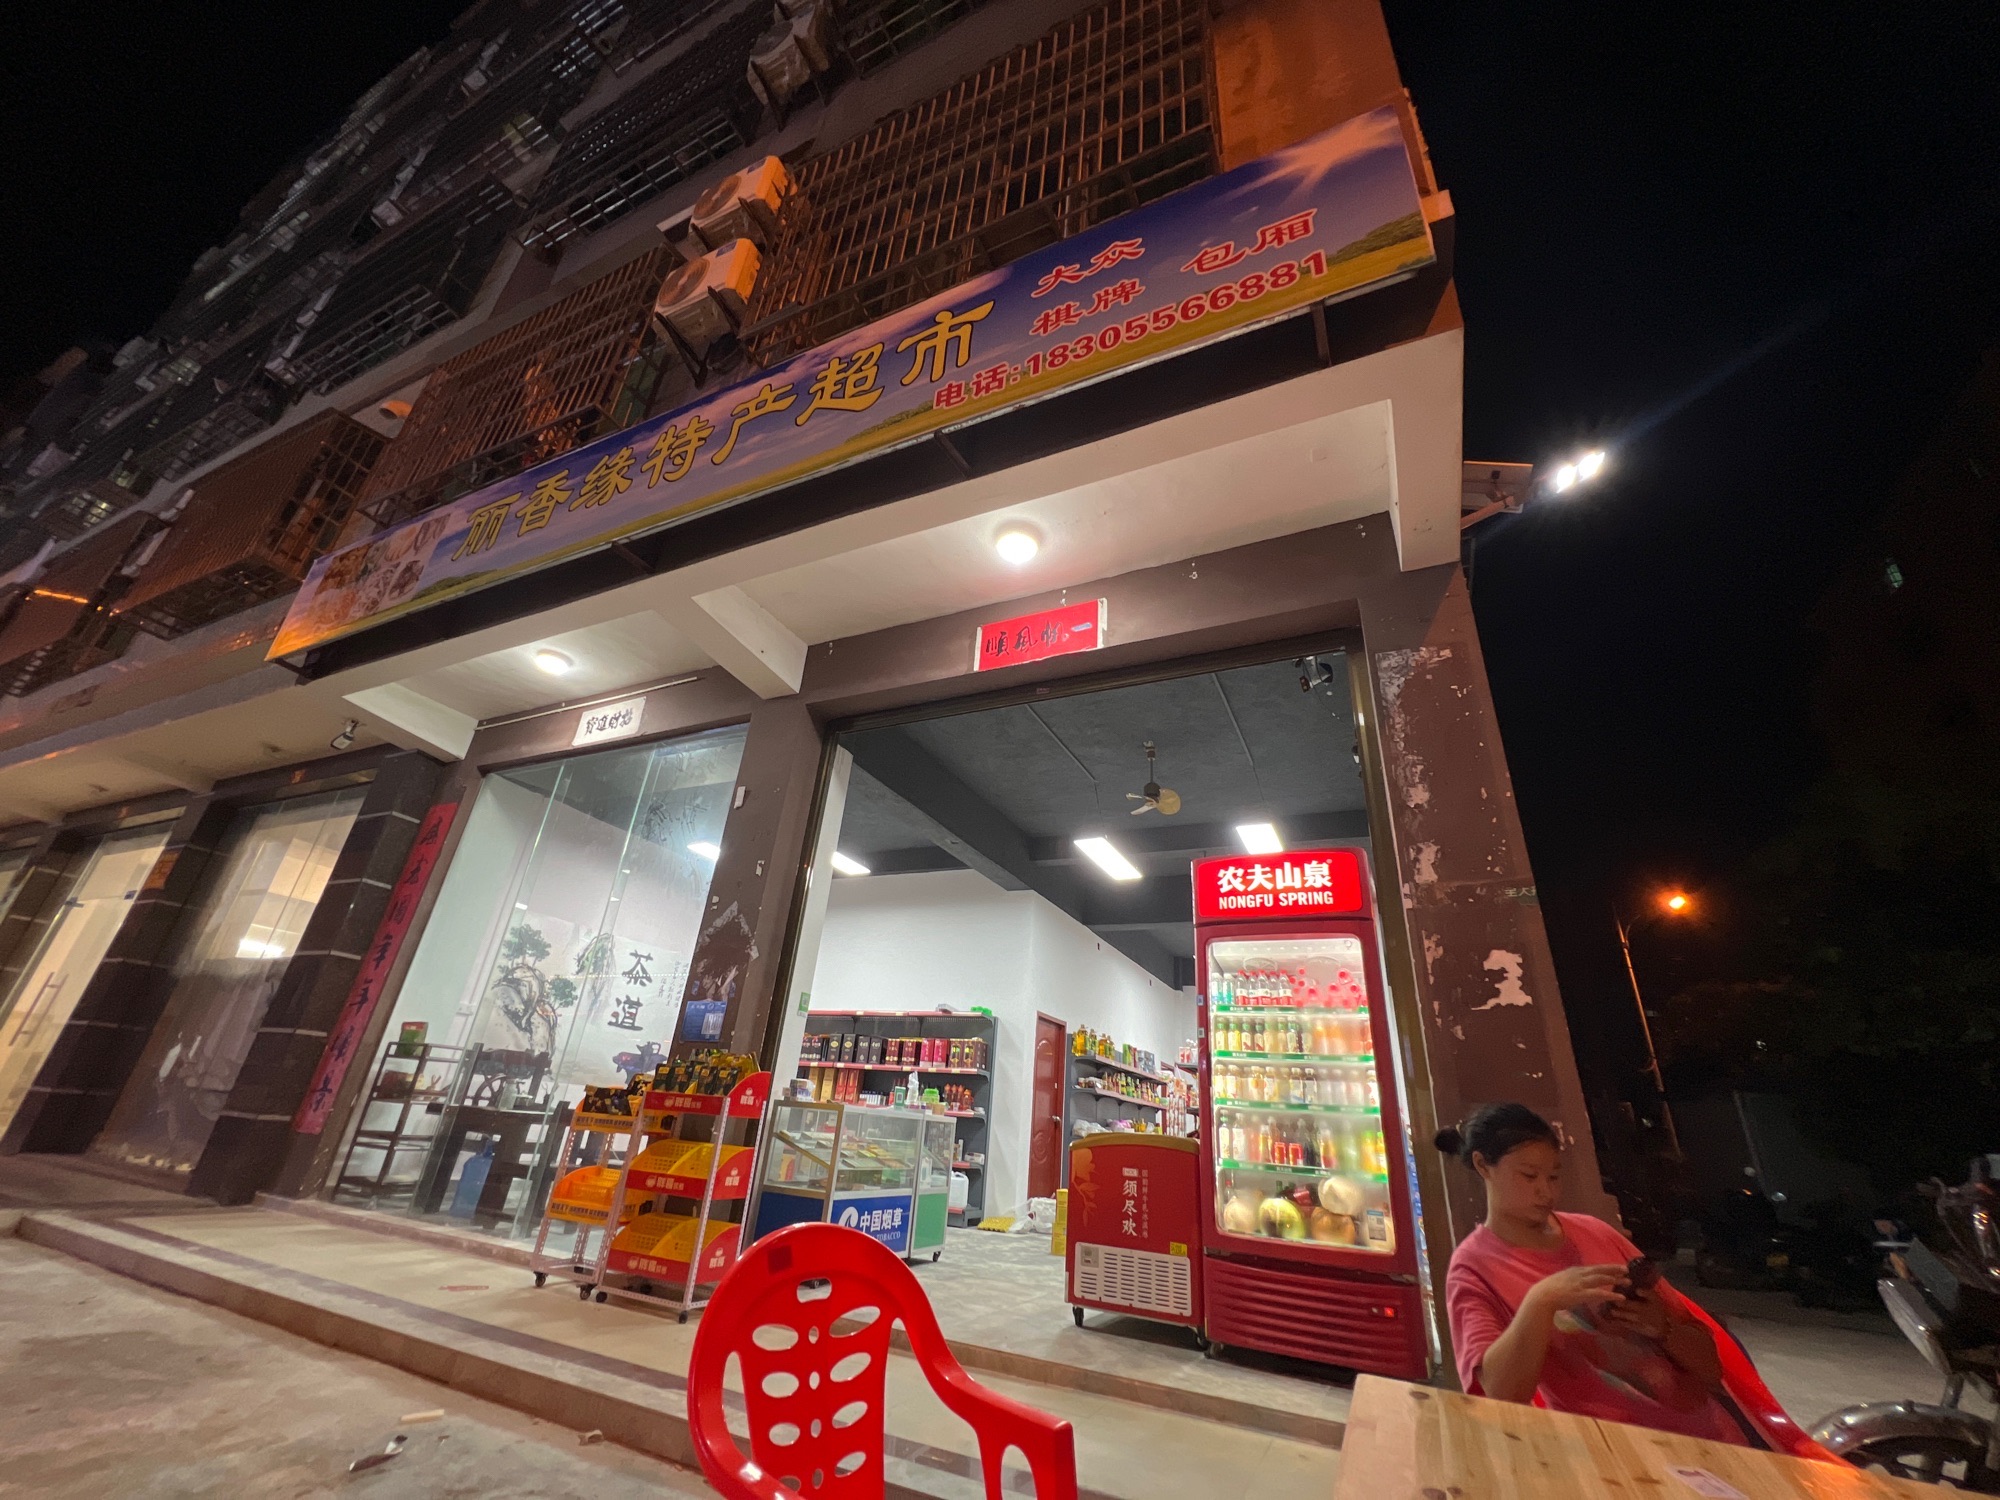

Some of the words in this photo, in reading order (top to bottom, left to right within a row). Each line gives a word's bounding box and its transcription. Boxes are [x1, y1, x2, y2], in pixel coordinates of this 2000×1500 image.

[1030, 237, 1145, 298] 大众
[1180, 207, 1319, 274] 包厢
[1029, 278, 1146, 337] 棋牌
[450, 300, 996, 561] 丽香缘特产超市
[1217, 860, 1333, 894] 农夫山泉
[1219, 893, 1274, 910] NONGFU
[1278, 891, 1334, 907] SPRING
[860, 1207, 903, 1233] 中国烟草
[1122, 1179, 1138, 1237] 须尽欢
